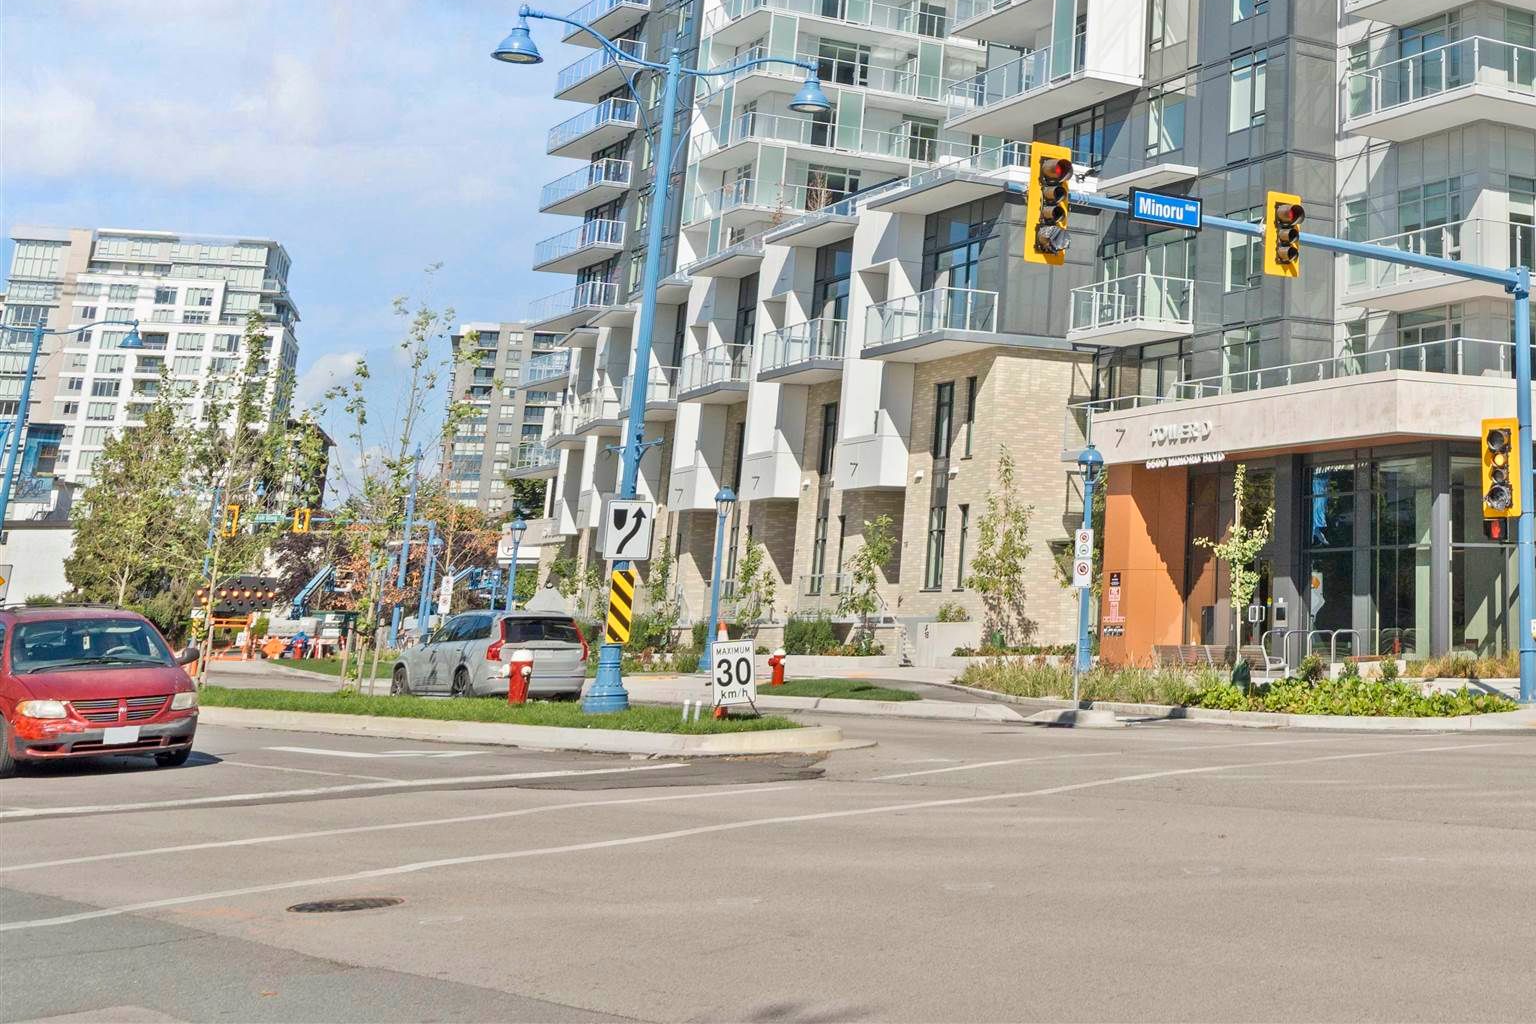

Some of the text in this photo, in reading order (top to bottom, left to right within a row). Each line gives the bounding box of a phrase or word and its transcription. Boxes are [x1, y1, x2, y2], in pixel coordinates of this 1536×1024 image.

[1139, 196, 1184, 220] Minoru
[1149, 422, 1200, 443] TOWER
[716, 646, 750, 655] MAXIMUM
[716, 657, 751, 687] 30
[721, 687, 748, 699] km/h
